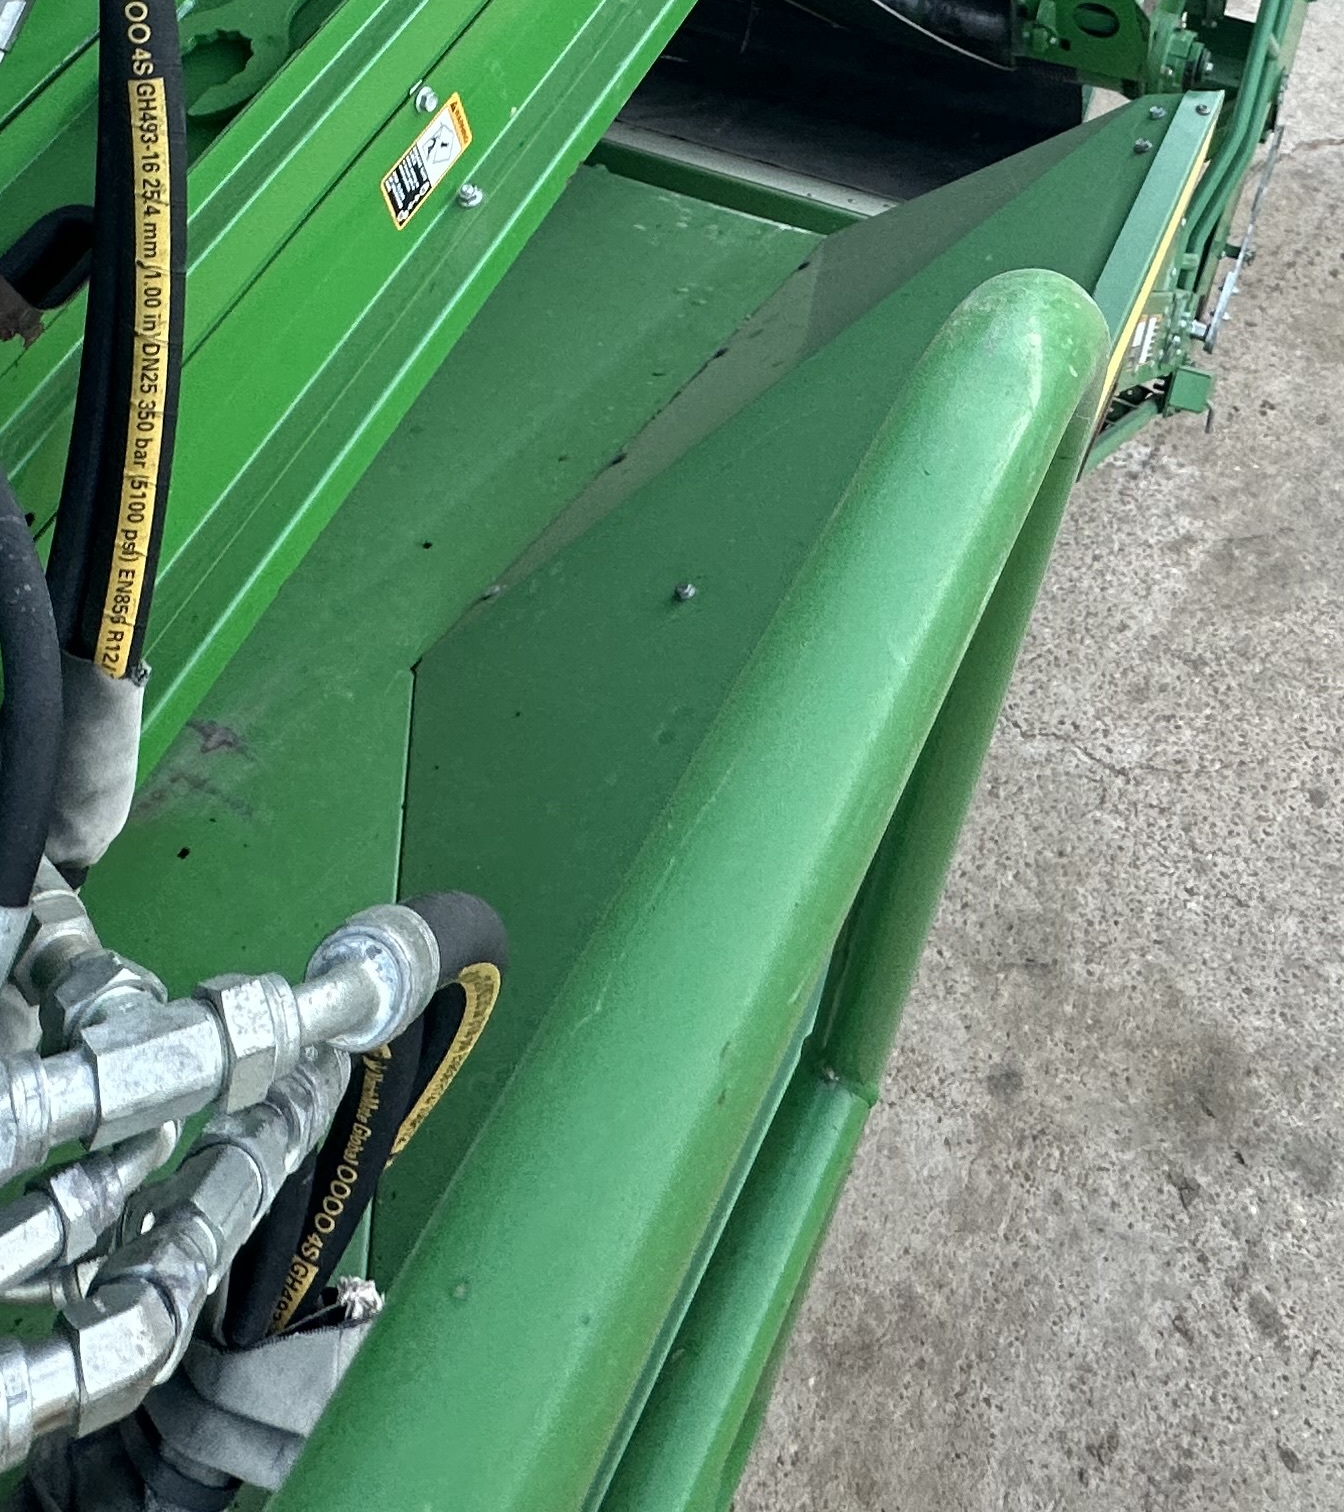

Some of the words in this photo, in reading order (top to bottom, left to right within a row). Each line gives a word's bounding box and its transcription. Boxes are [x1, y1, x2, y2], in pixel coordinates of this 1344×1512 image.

[131, 47, 154, 76] 4S
[136, 83, 160, 173] GH493-16
[141, 177, 161, 217] 25.4
[142, 220, 158, 258] mm
[139, 343, 160, 393] DN25
[138, 401, 156, 432] 350
[133, 438, 153, 468] bar
[118, 527, 140, 564] psi)
[110, 567, 136, 624] EN856
[343, 1121, 372, 1166] Global
[301, 1233, 324, 1260] 4S
